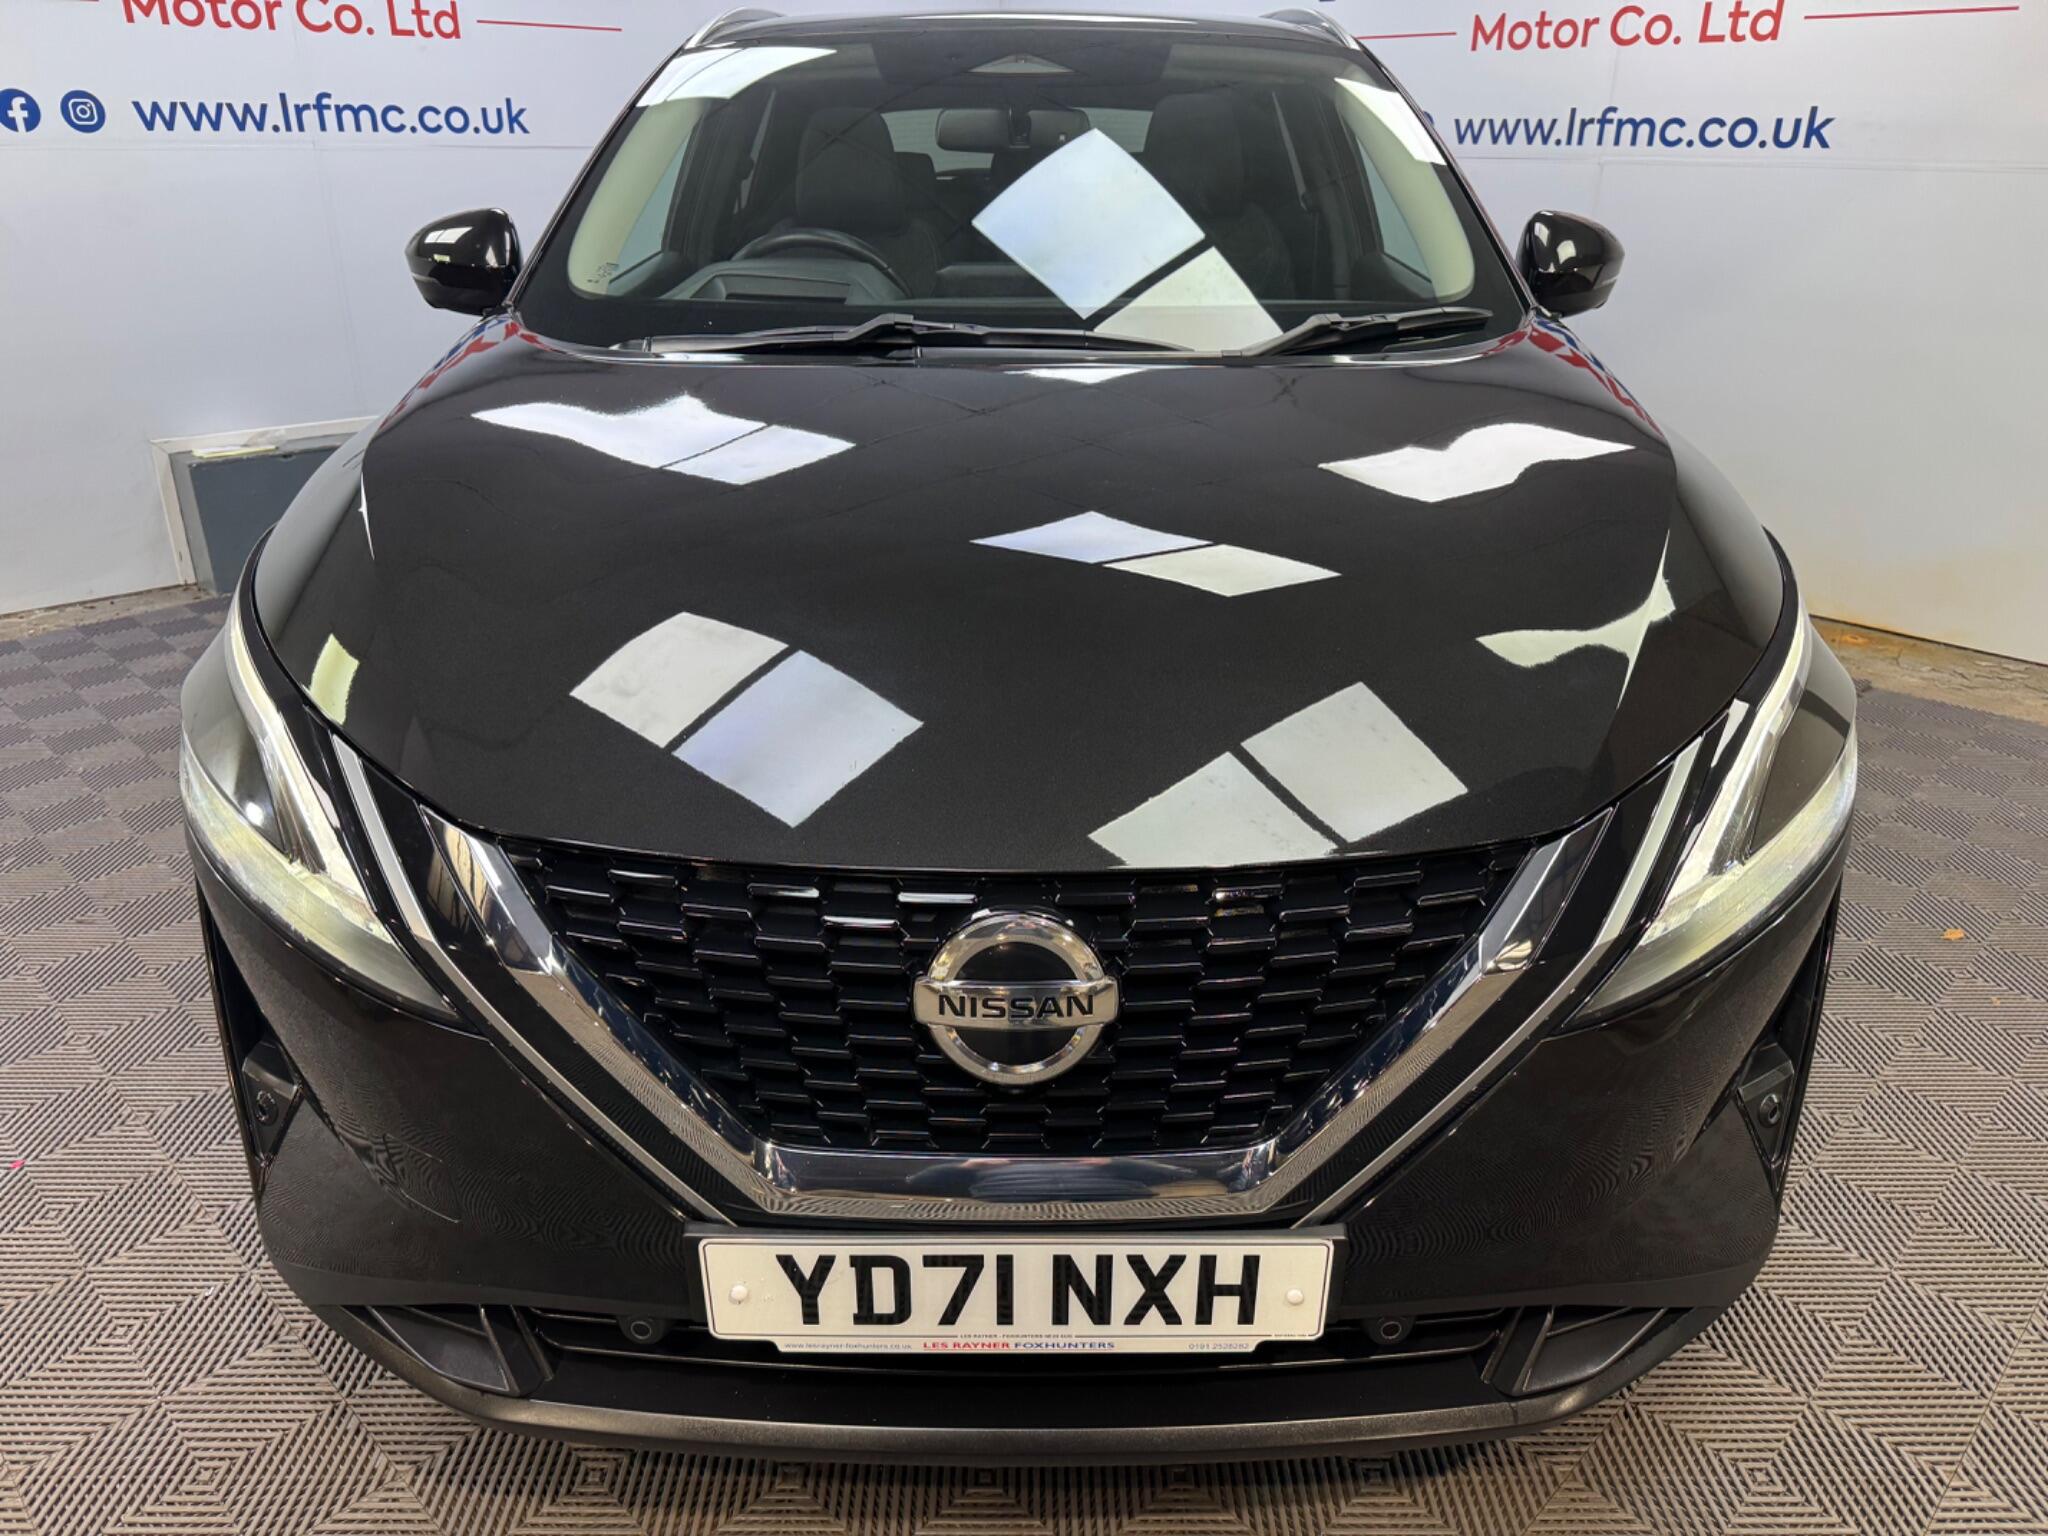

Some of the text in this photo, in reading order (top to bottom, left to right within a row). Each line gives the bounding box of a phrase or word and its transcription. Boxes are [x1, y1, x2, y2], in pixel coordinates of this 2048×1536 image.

[122, 0, 462, 40] Motor Co. Ltd
[1471, 0, 1785, 51] Motor Co. Ltd
[132, 92, 530, 135] www.lrfmc.co.uk
[1453, 106, 1836, 149] www.lrfmc.co.uk
[938, 994, 1094, 1019] NISSAN
[776, 1254, 1261, 1326] YD71 NXH
[923, 1341, 1115, 1349] LES RAYNER FOXHUNTERS
